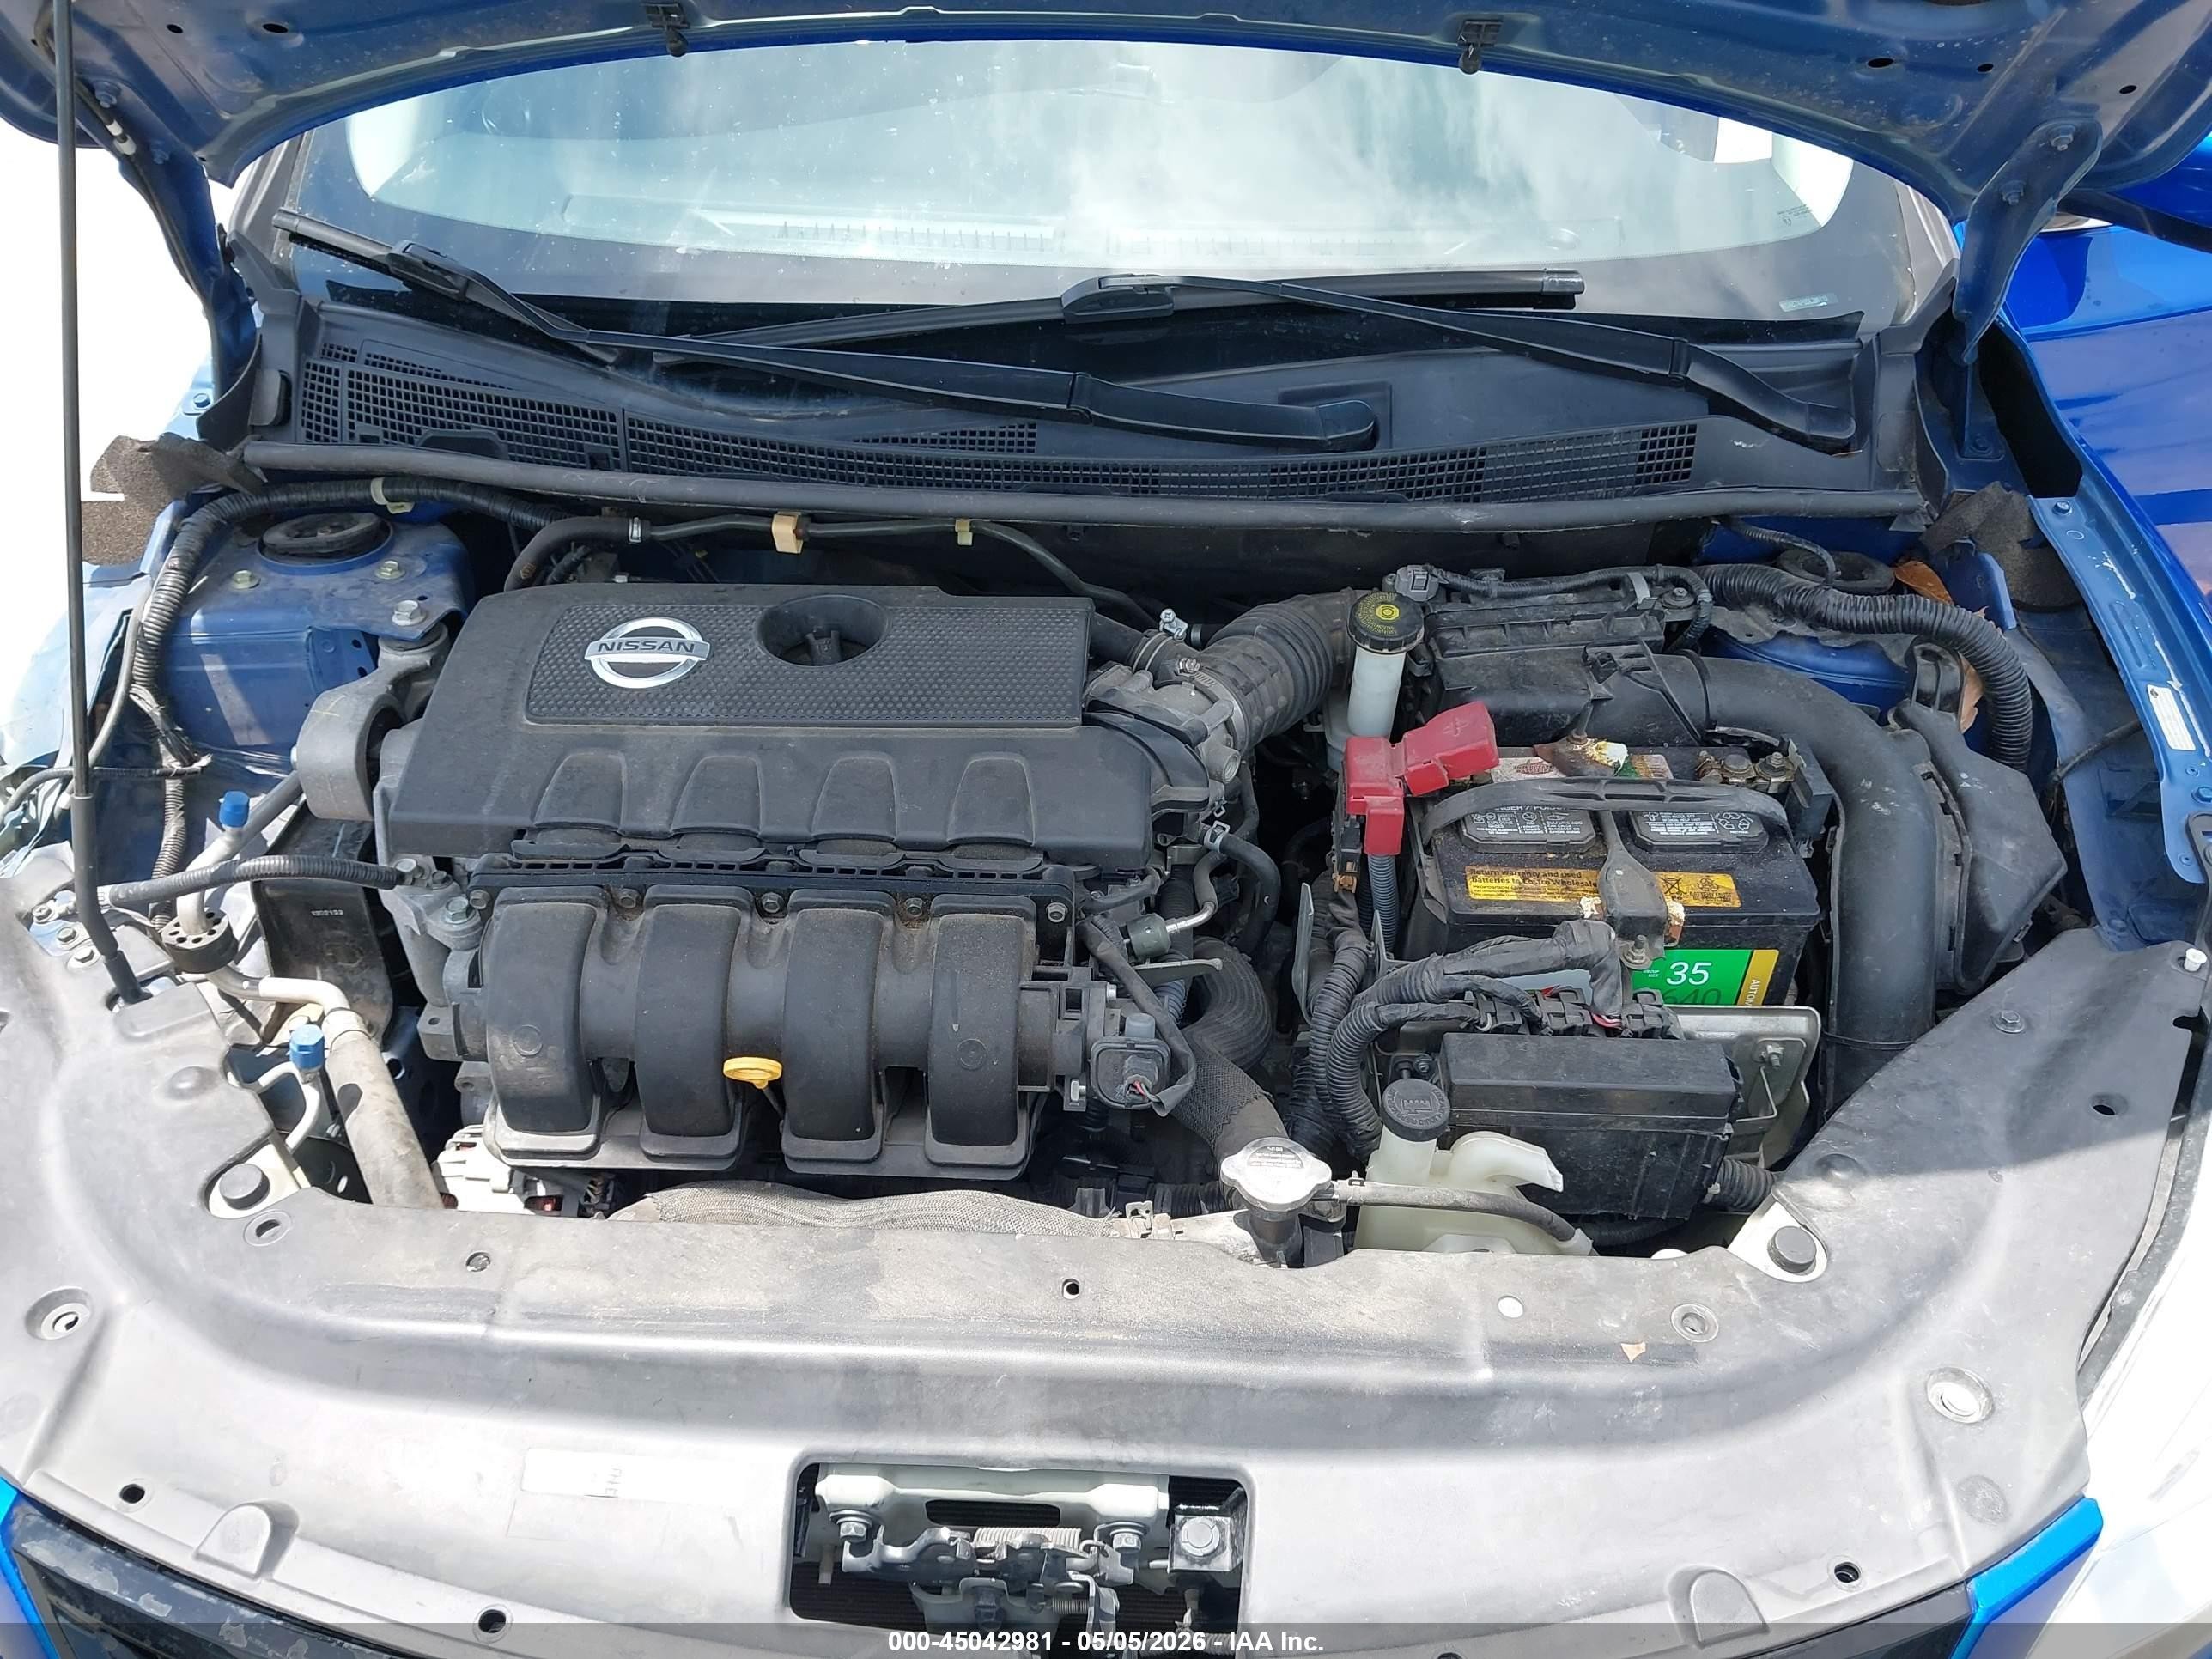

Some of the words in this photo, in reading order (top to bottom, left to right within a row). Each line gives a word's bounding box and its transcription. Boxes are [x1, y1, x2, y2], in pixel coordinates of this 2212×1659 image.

[598, 641, 695, 653] NISSAN
[1502, 869, 1540, 879] warranty
[1541, 870, 1559, 878] and
[1472, 875, 1510, 884] batteries
[1511, 877, 1520, 885] to
[1552, 878, 1598, 888] Wholesale
[1666, 961, 1712, 986] 35
